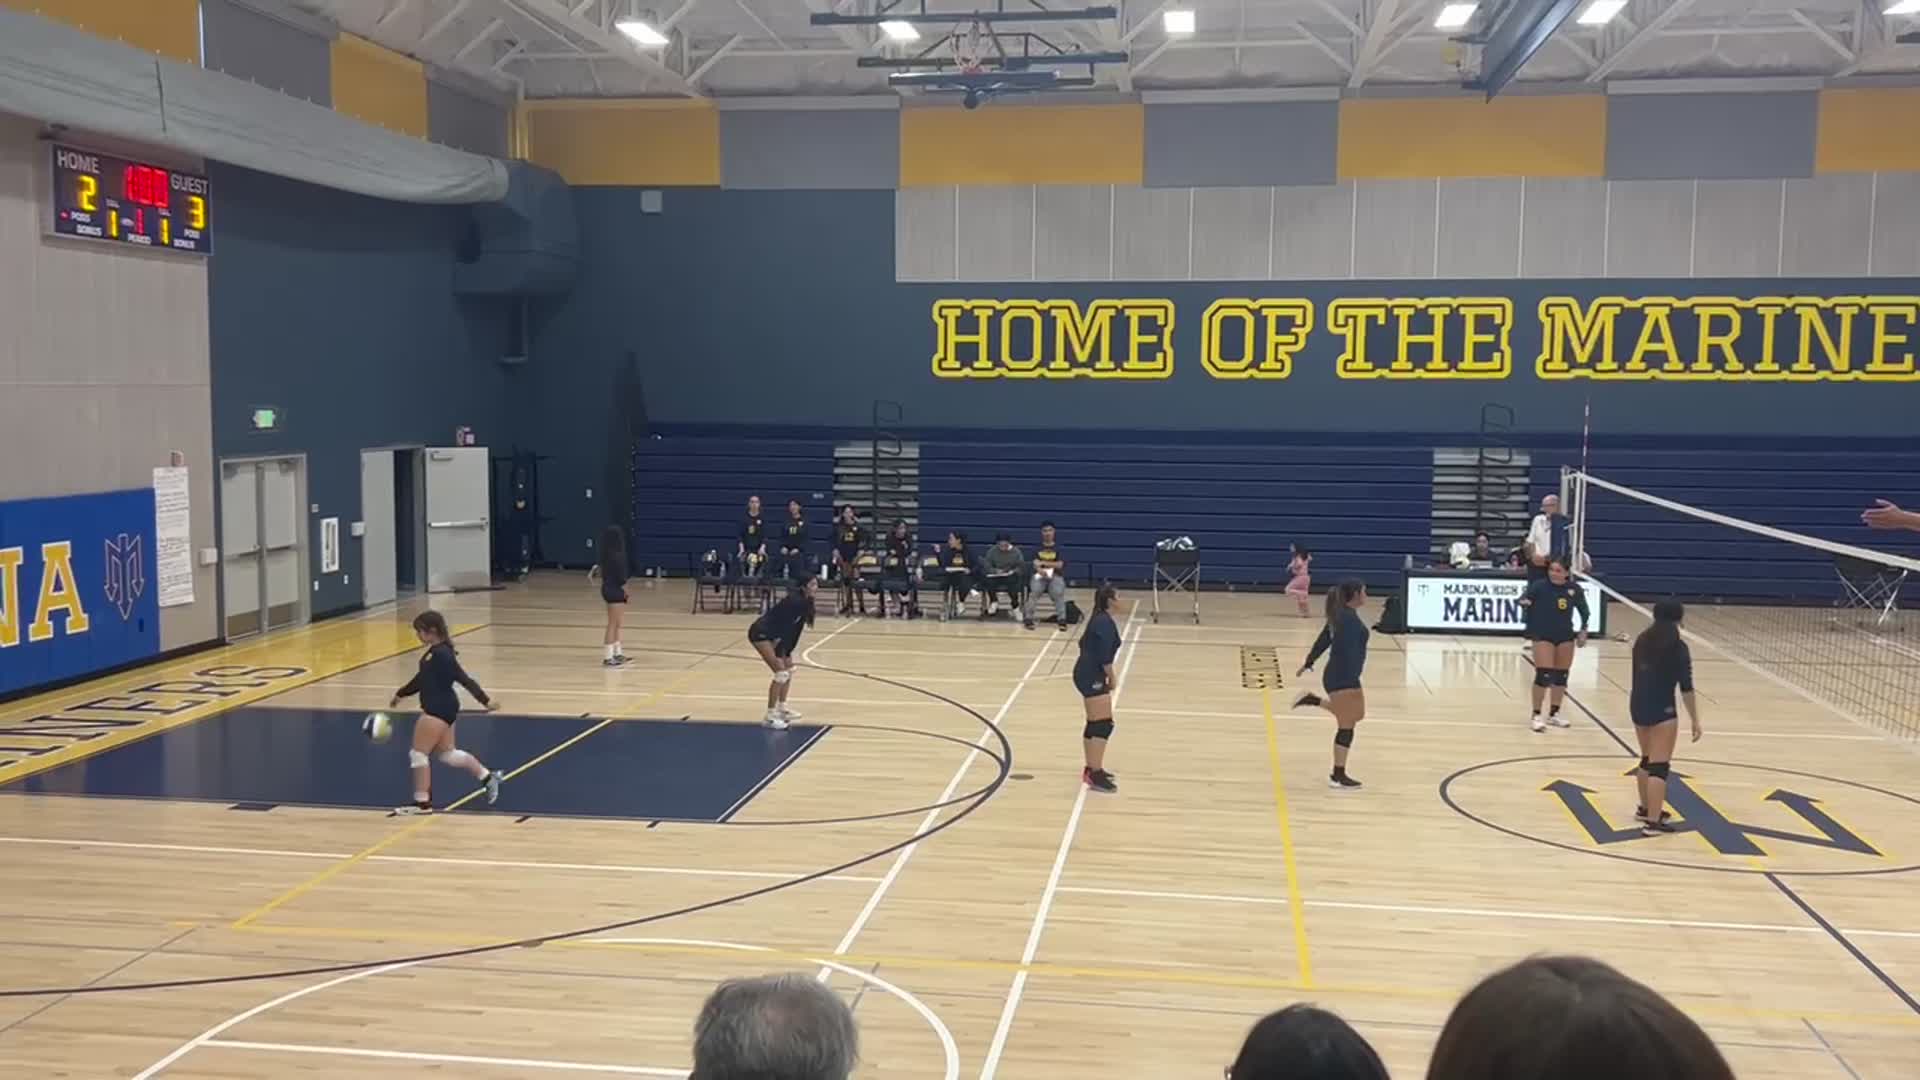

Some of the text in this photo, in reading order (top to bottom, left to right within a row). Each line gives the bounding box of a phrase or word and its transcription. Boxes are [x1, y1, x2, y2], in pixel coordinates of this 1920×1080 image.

[57, 150, 100, 173] HOME
[78, 175, 97, 211] 2
[170, 173, 208, 194] GUEST
[109, 209, 118, 238] 1
[187, 196, 206, 229] 3
[160, 217, 169, 246] 1
[932, 296, 1920, 381] HOME OF THE MARINE
[1443, 584, 1489, 595] MARINA
[1492, 584, 1518, 596] HIGH
[1557, 598, 1568, 610] 6
